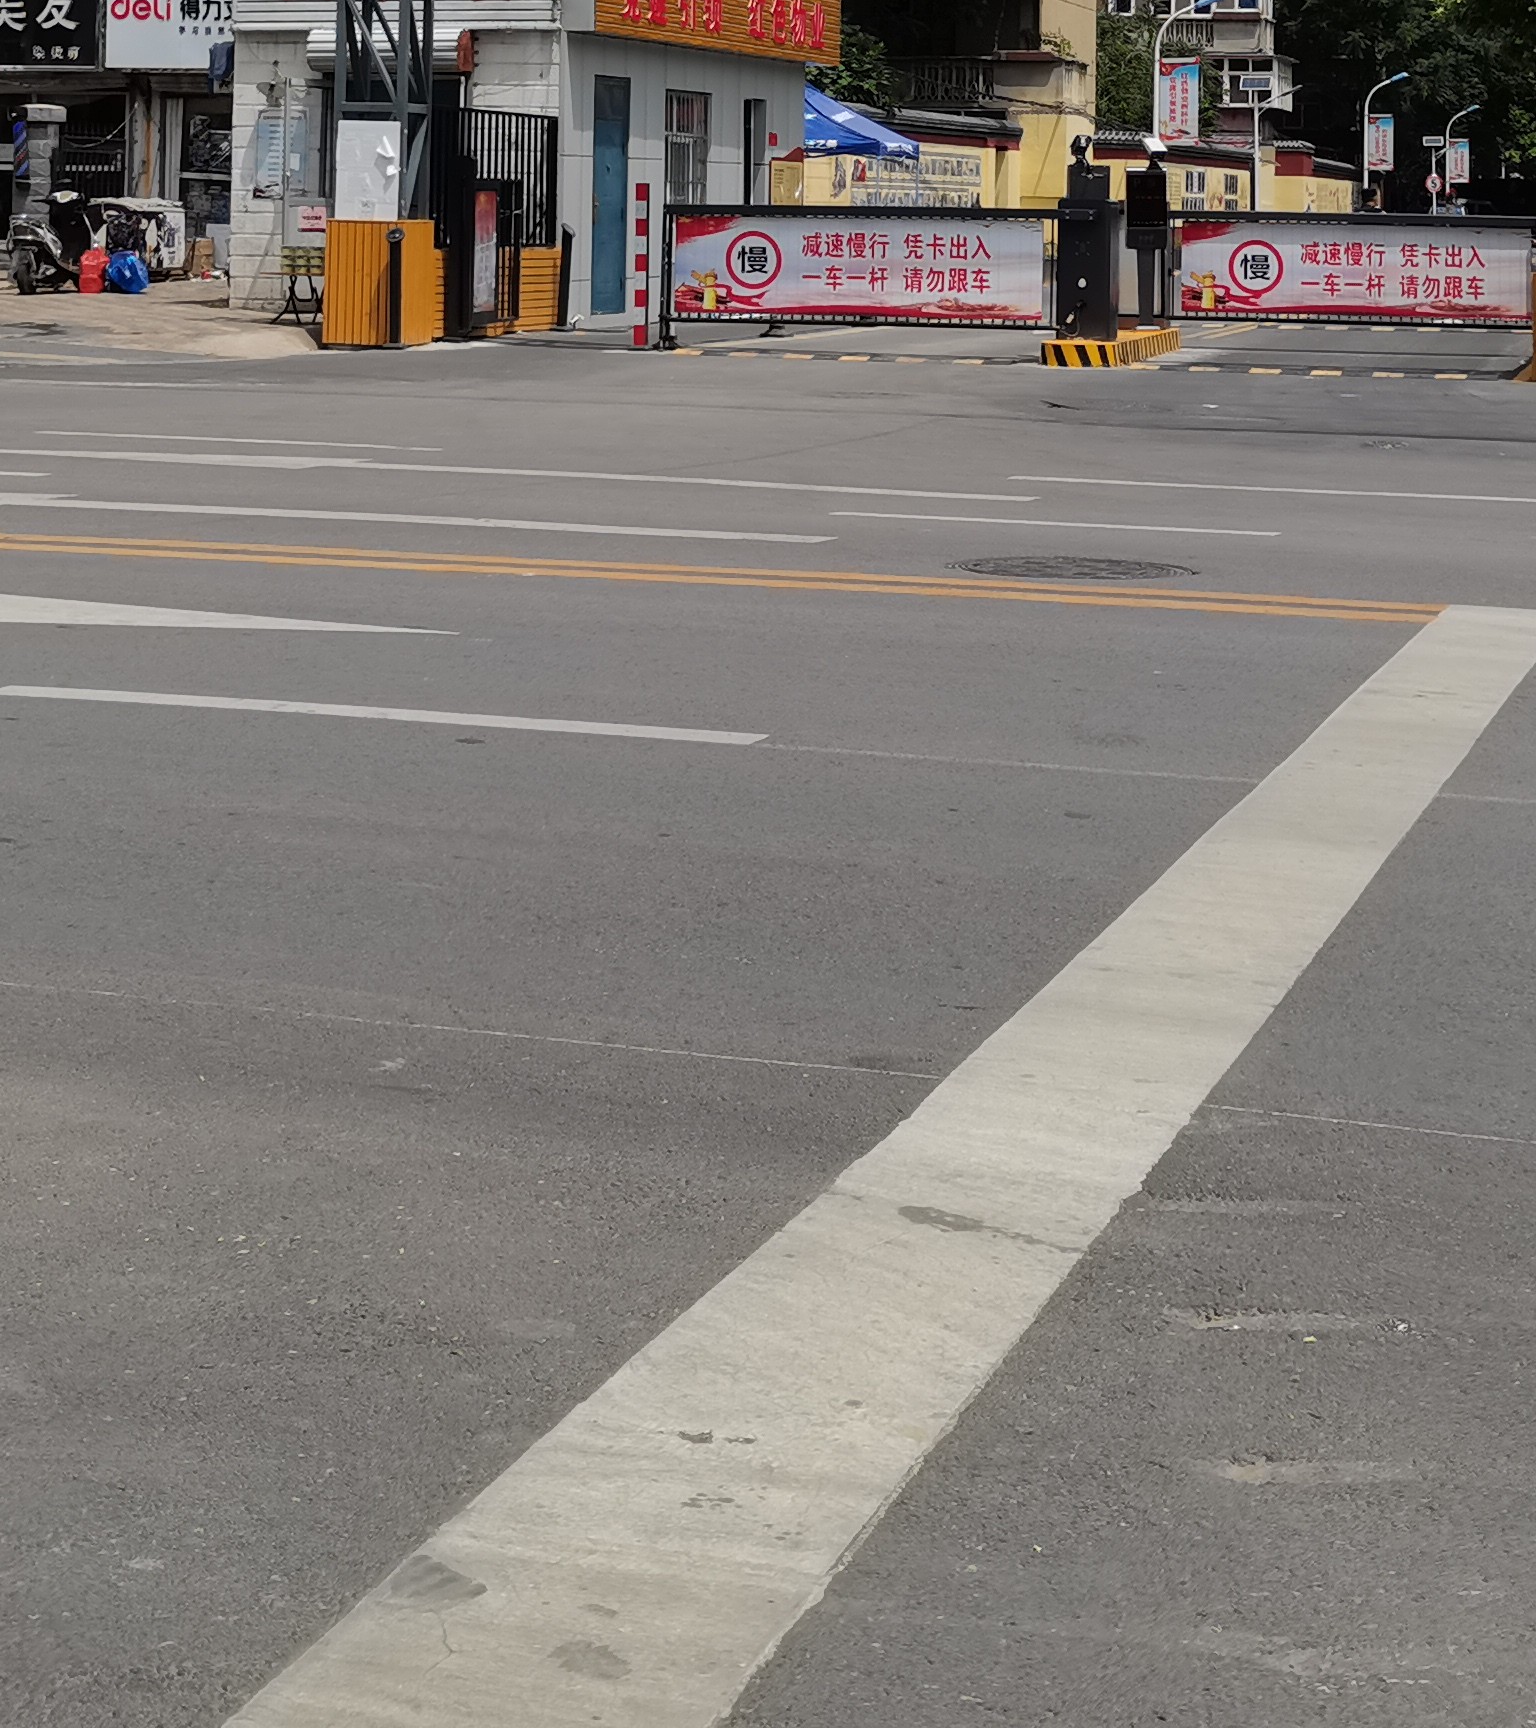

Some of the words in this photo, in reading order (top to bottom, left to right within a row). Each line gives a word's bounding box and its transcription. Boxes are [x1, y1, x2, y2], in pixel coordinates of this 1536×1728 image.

[737, 245, 768, 274] 慢
[801, 231, 889, 260] 减速慢行
[903, 233, 992, 261] 凭卡出入
[1300, 242, 1386, 268] 减速慢行
[1399, 243, 1486, 269] 凭卡出入
[801, 265, 889, 292] 一车一杆
[903, 266, 992, 294] 请勿跟车
[1239, 253, 1271, 281] 慢
[1300, 273, 1386, 299] 一车一杆
[1399, 274, 1486, 301] 请勿跟车
